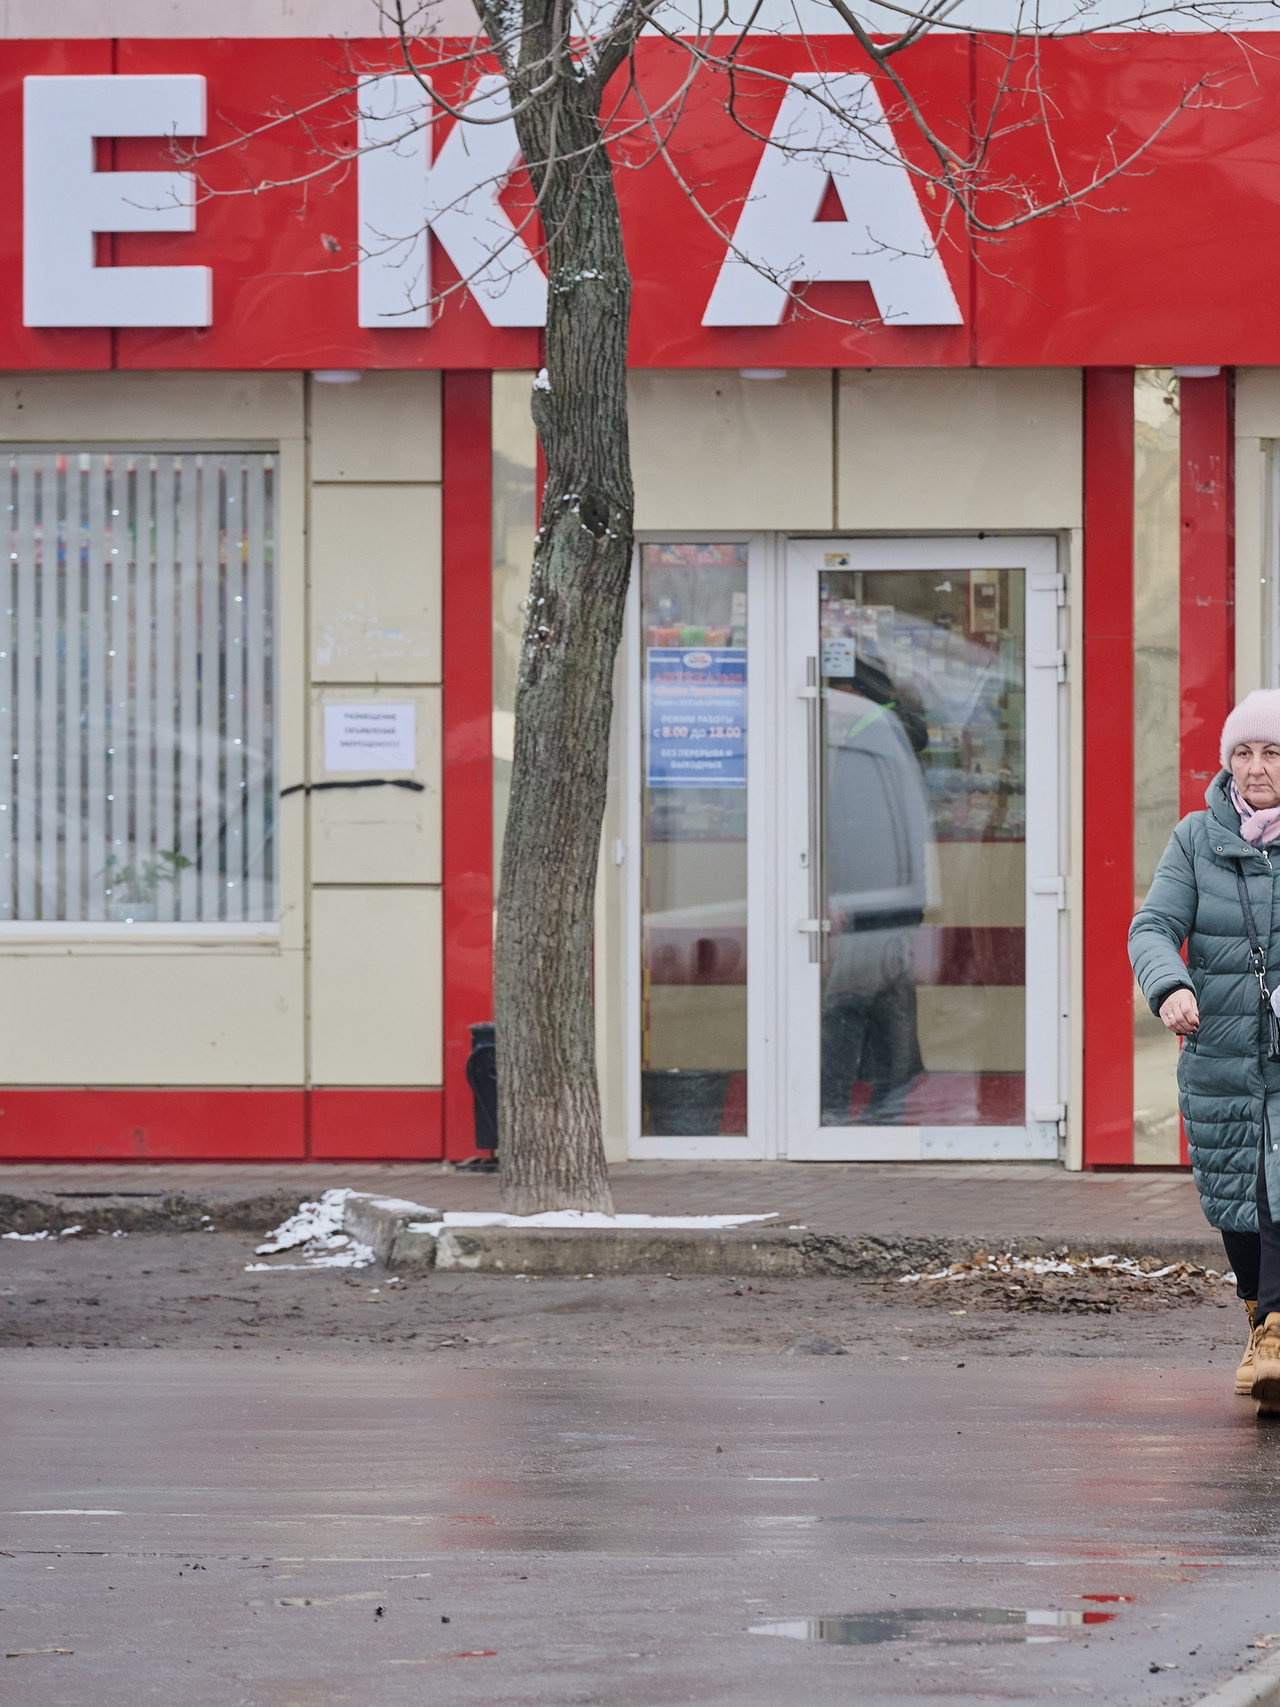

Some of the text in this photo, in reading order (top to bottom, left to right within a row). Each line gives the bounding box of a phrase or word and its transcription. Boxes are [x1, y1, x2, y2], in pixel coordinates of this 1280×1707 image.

[661, 715, 734, 724] РЕЖИМ РАБОТЫ
[662, 726, 688, 738] 8.00
[689, 728, 707, 740] до
[661, 749, 677, 757] БЕЗ
[678, 749, 725, 757] ПЕРЕРЫВА
[670, 760, 723, 769] ВЫХОДНЫХ
